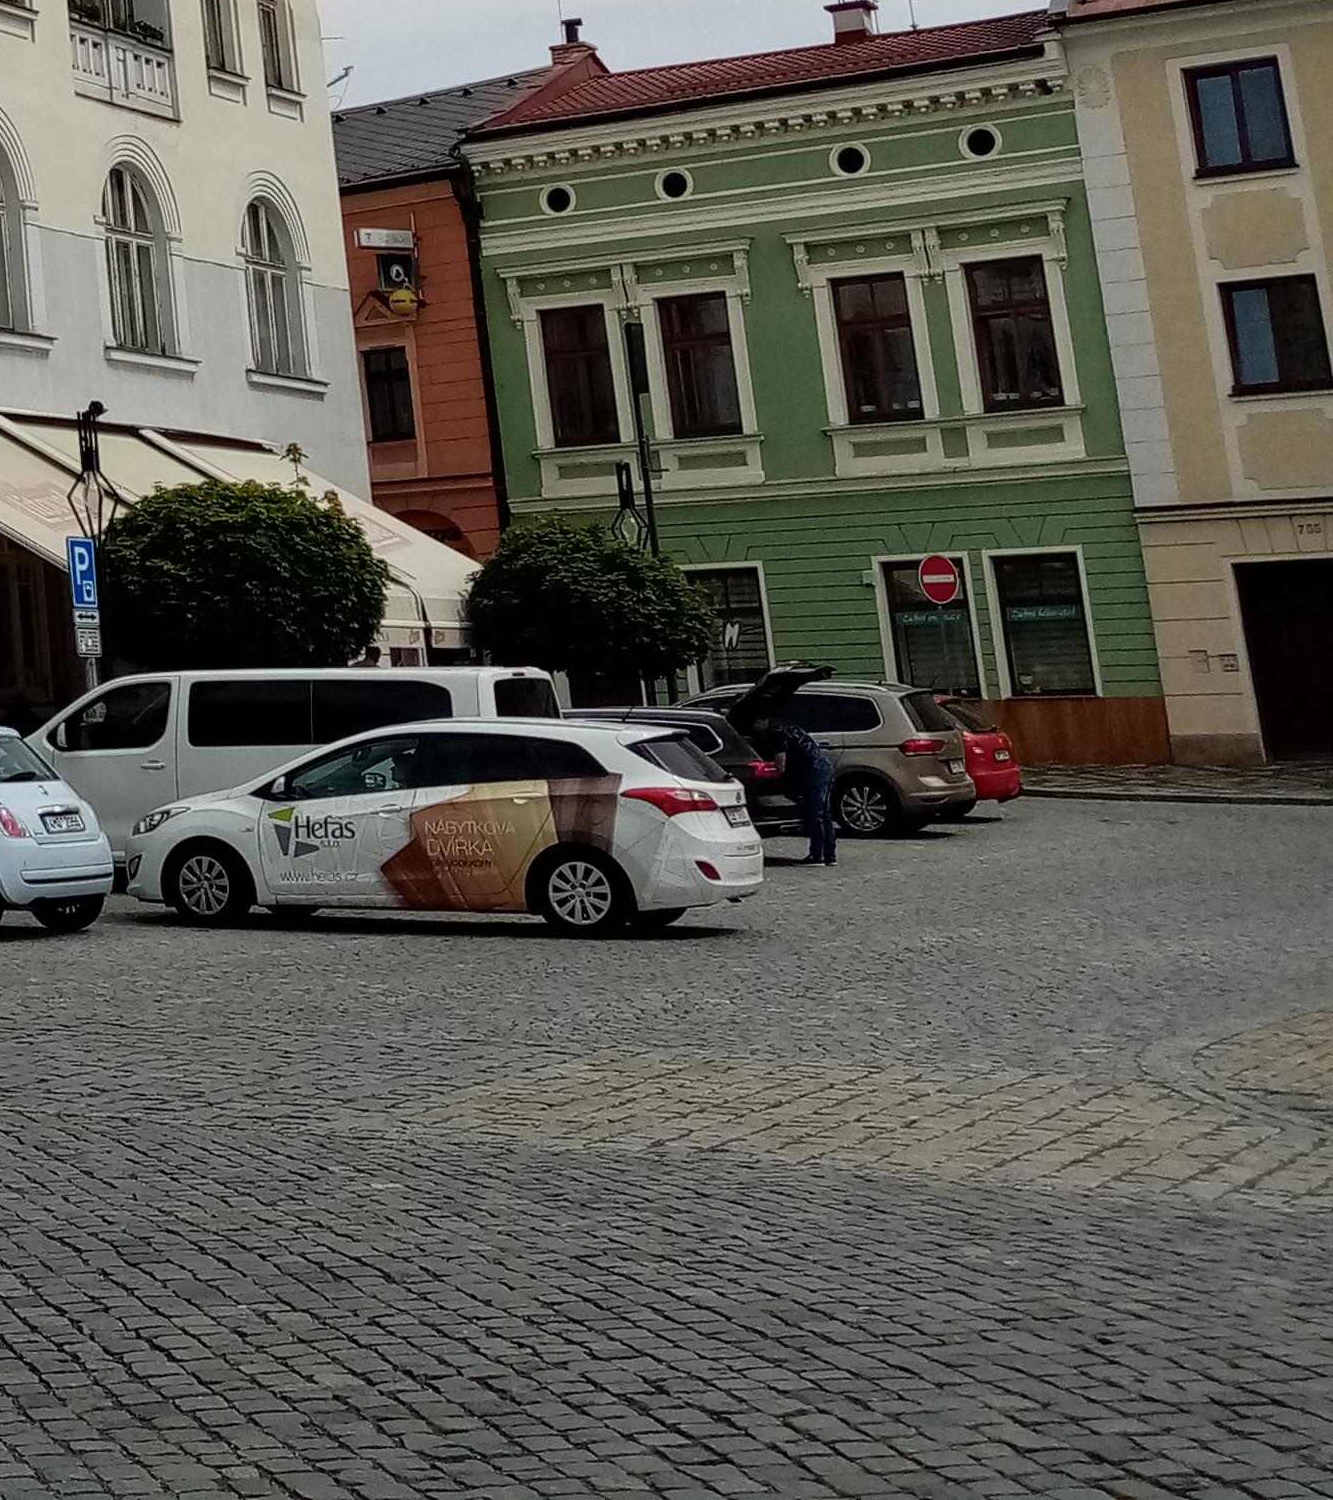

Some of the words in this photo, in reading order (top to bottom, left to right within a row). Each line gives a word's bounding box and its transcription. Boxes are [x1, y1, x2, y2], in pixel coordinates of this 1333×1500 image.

[73, 545, 90, 585] P
[294, 815, 356, 839] Hefas
[426, 835, 495, 858] DVÍŘKA
